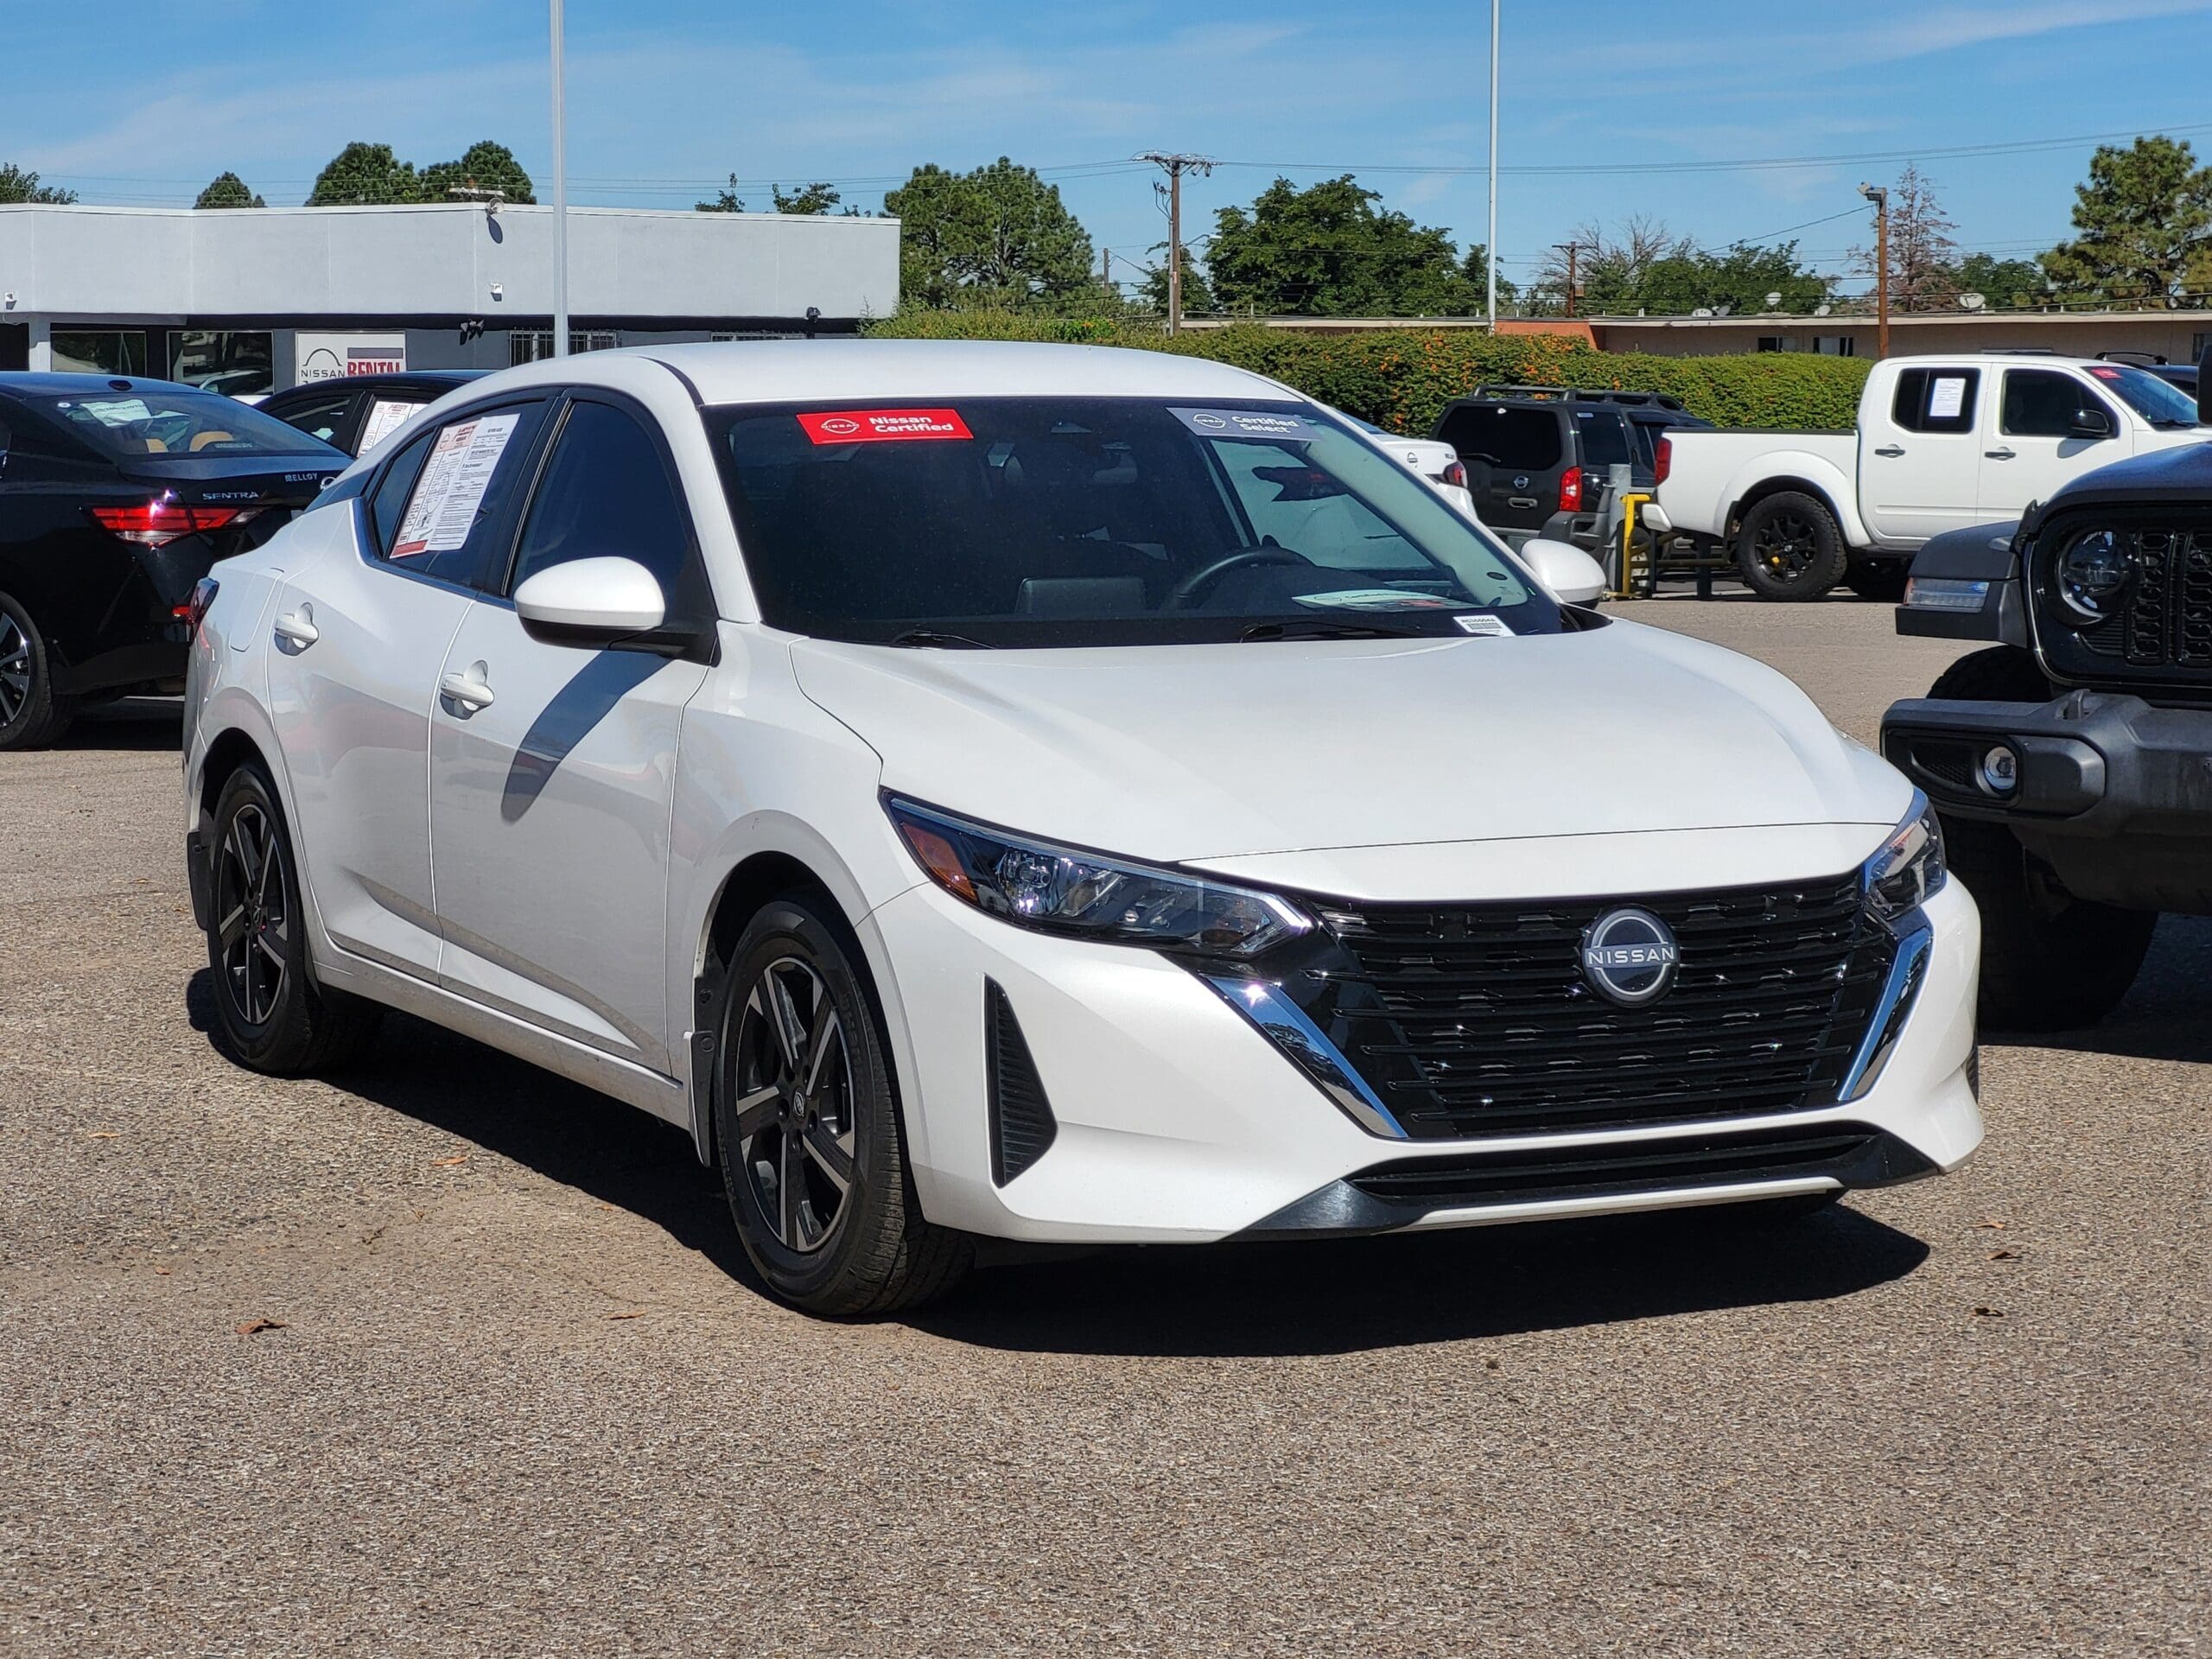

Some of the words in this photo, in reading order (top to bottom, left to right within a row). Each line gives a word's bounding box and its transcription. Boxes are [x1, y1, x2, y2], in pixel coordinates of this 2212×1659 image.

[301, 369, 345, 378] NISSAN
[868, 416, 932, 425] Nissan
[1231, 416, 1300, 428] Certified
[874, 423, 955, 433] Certified
[1240, 423, 1292, 434] Select
[285, 473, 318, 482] MELLOY
[202, 491, 259, 500] SENTRA
[1587, 946, 1675, 965] NISSAN
